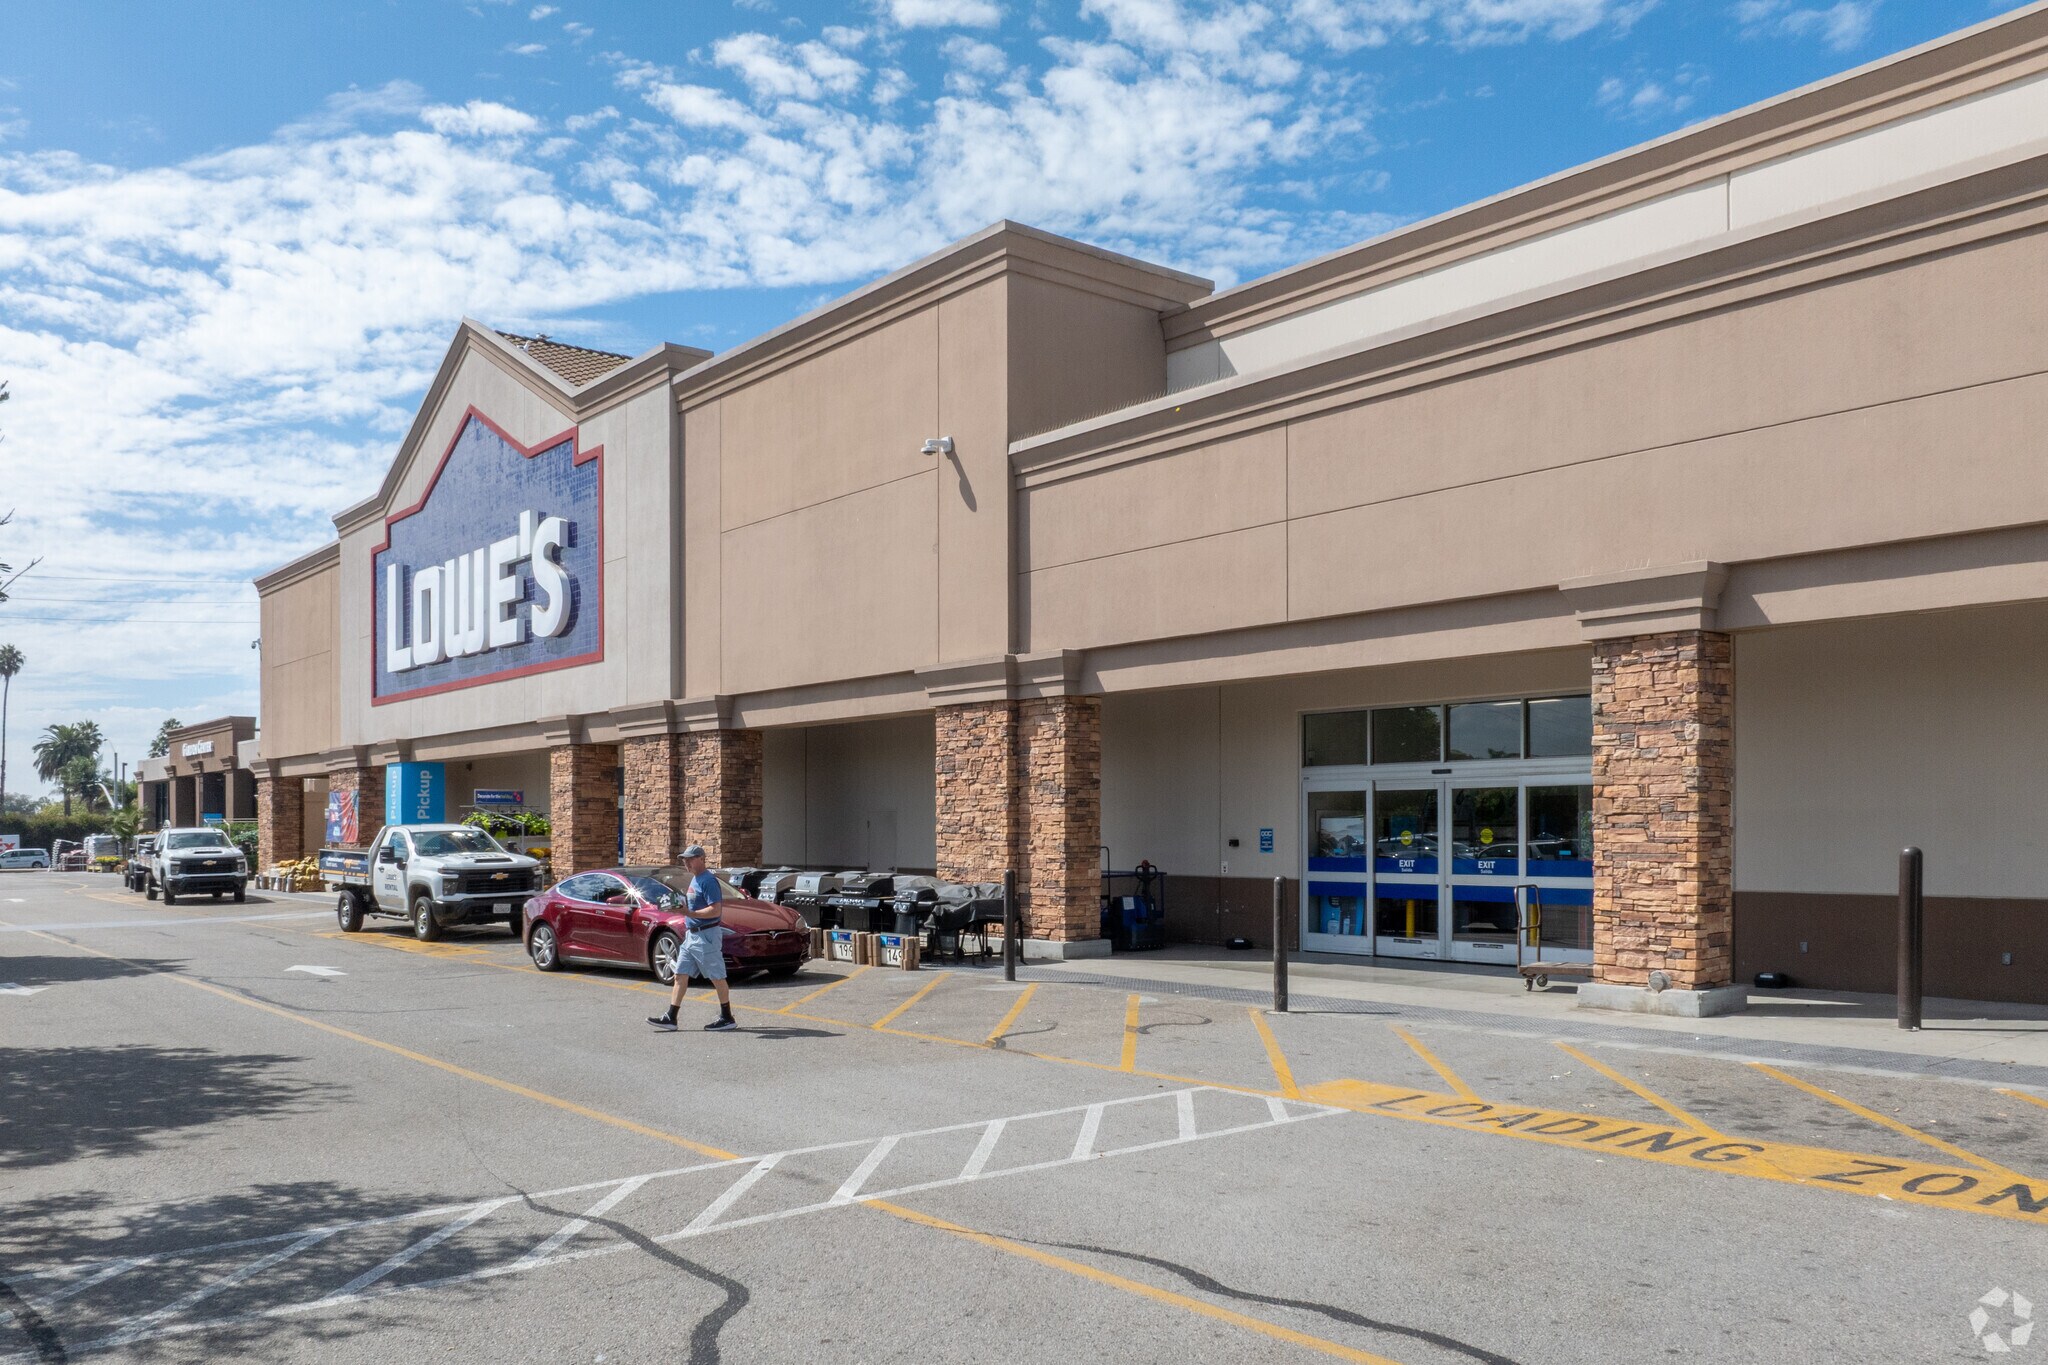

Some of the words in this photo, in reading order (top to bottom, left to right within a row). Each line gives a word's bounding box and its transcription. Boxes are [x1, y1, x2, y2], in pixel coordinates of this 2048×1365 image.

[387, 509, 572, 673] LOWE'S
[417, 770, 433, 820] Pickup
[1399, 860, 1415, 868] EXIT
[1478, 861, 1496, 869] EXIT
[1373, 1095, 1764, 1162] LOADING
